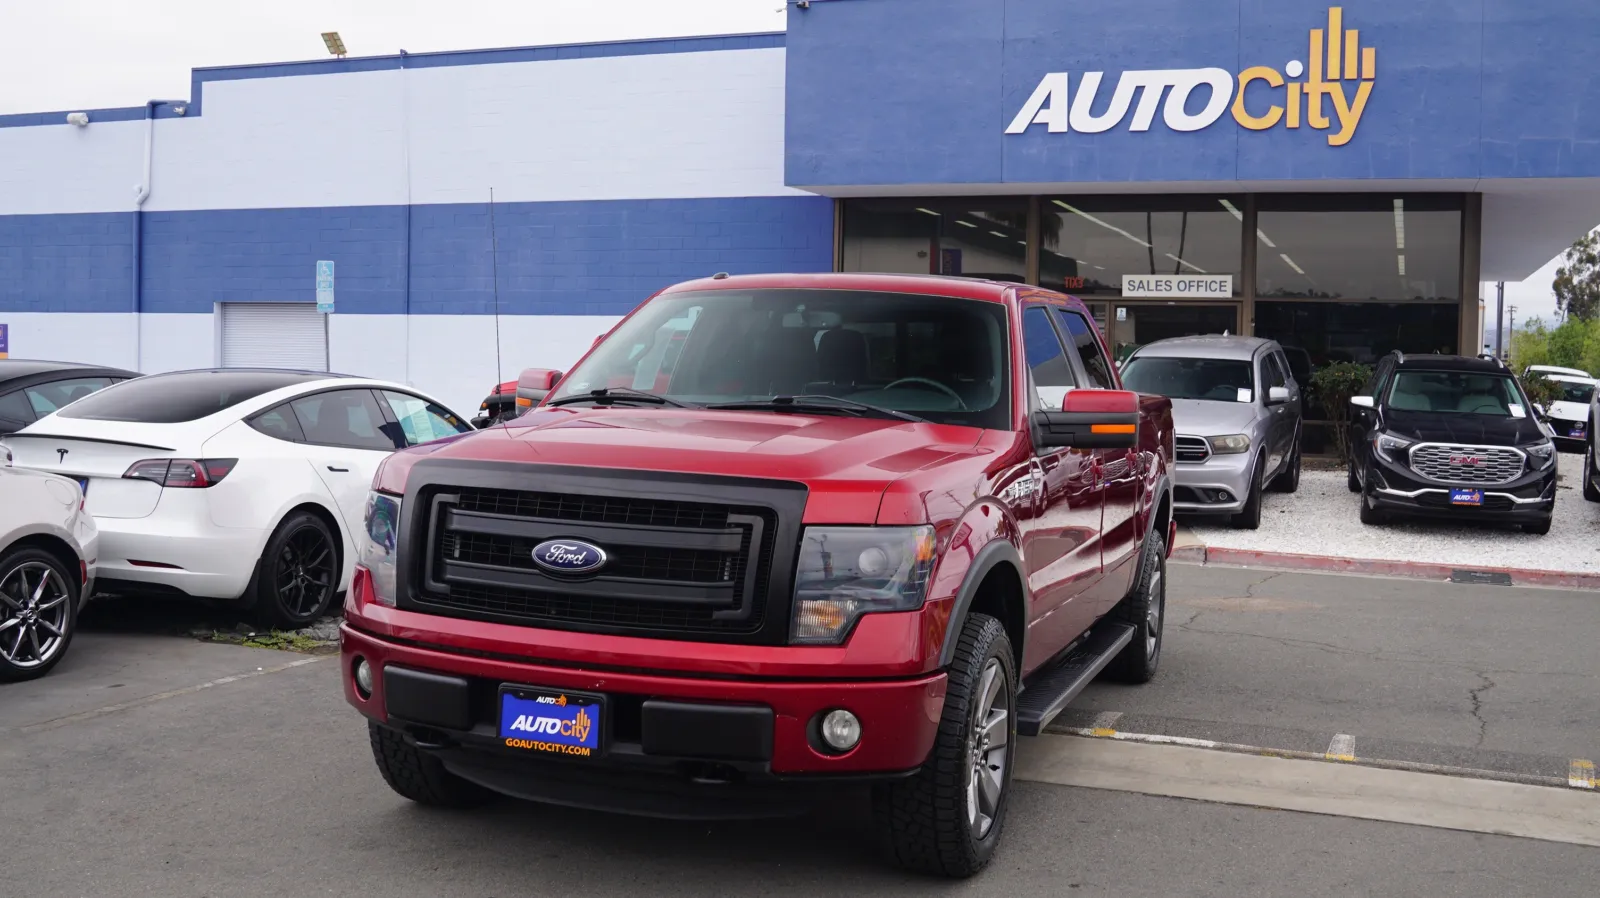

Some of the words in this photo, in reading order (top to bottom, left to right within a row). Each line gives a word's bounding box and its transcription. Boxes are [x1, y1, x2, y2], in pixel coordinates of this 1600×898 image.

[1127, 279, 1173, 292] SALES
[1177, 279, 1228, 292] OFFICE
[1450, 456, 1487, 468] GMC
[545, 544, 587, 565] Ford
[505, 738, 591, 756] GOAUTOCITY.COM
